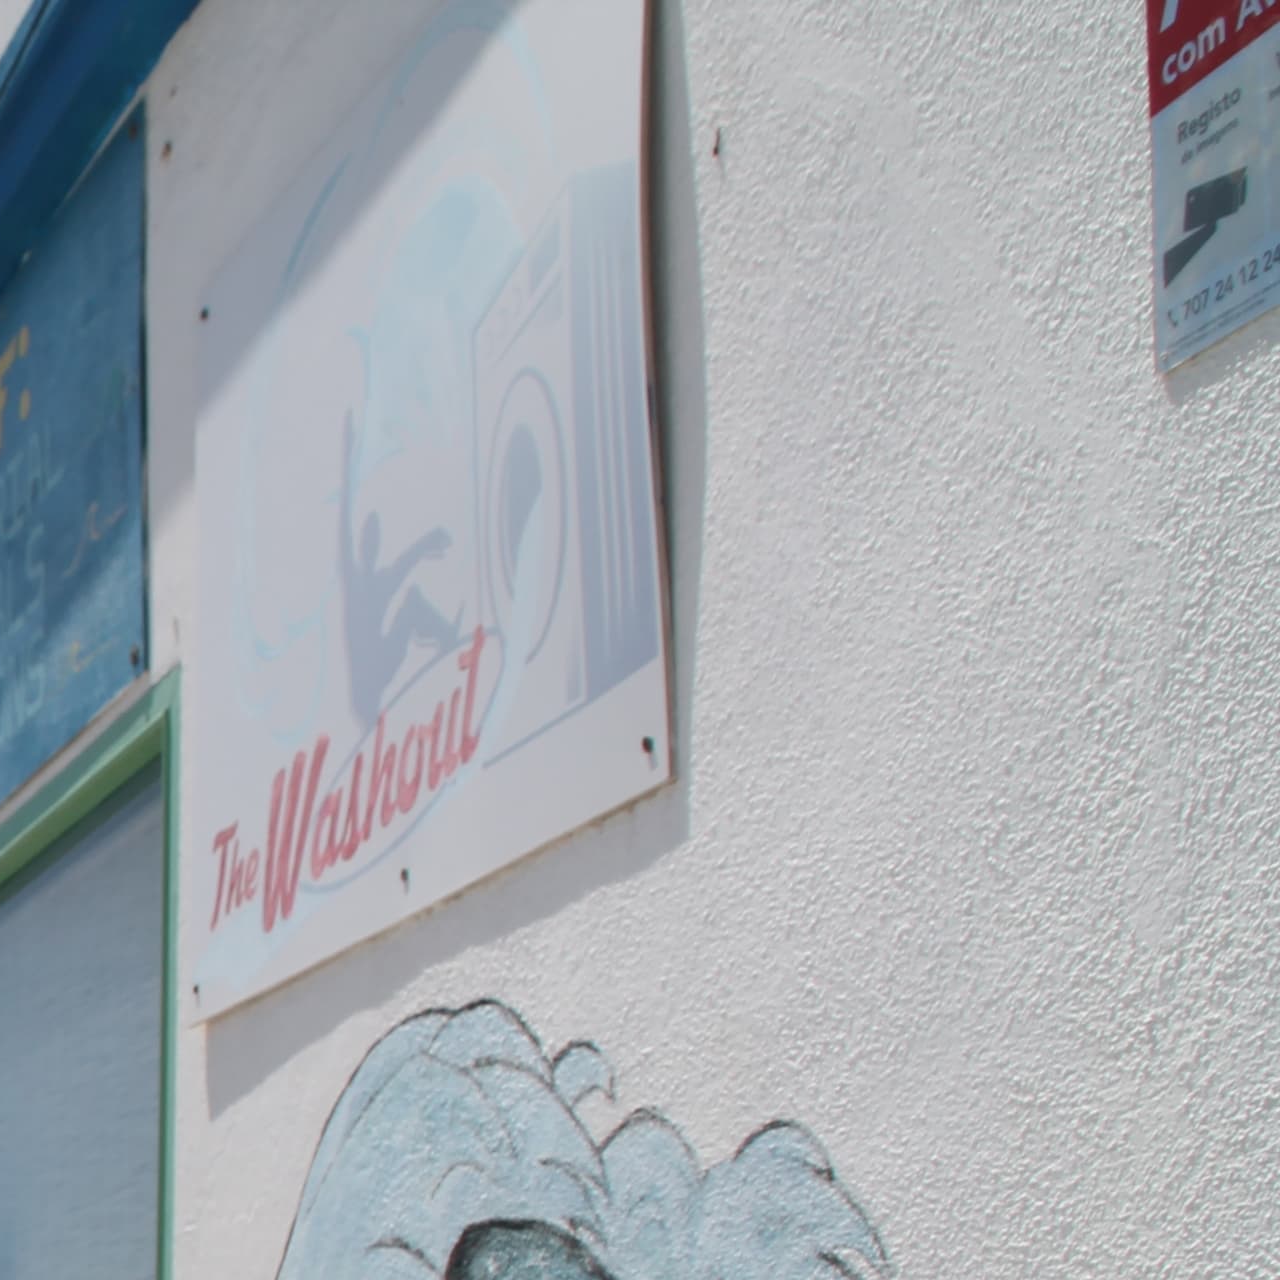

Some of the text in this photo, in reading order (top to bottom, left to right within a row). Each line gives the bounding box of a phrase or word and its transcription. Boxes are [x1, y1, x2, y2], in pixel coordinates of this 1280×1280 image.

[1162, 16, 1227, 85] com
[1176, 87, 1242, 145] Registo
[1183, 287, 1210, 320] 707
[1215, 274, 1235, 302] 24
[1238, 258, 1259, 286] 12
[209, 819, 260, 932] The
[261, 622, 488, 935] Washout
